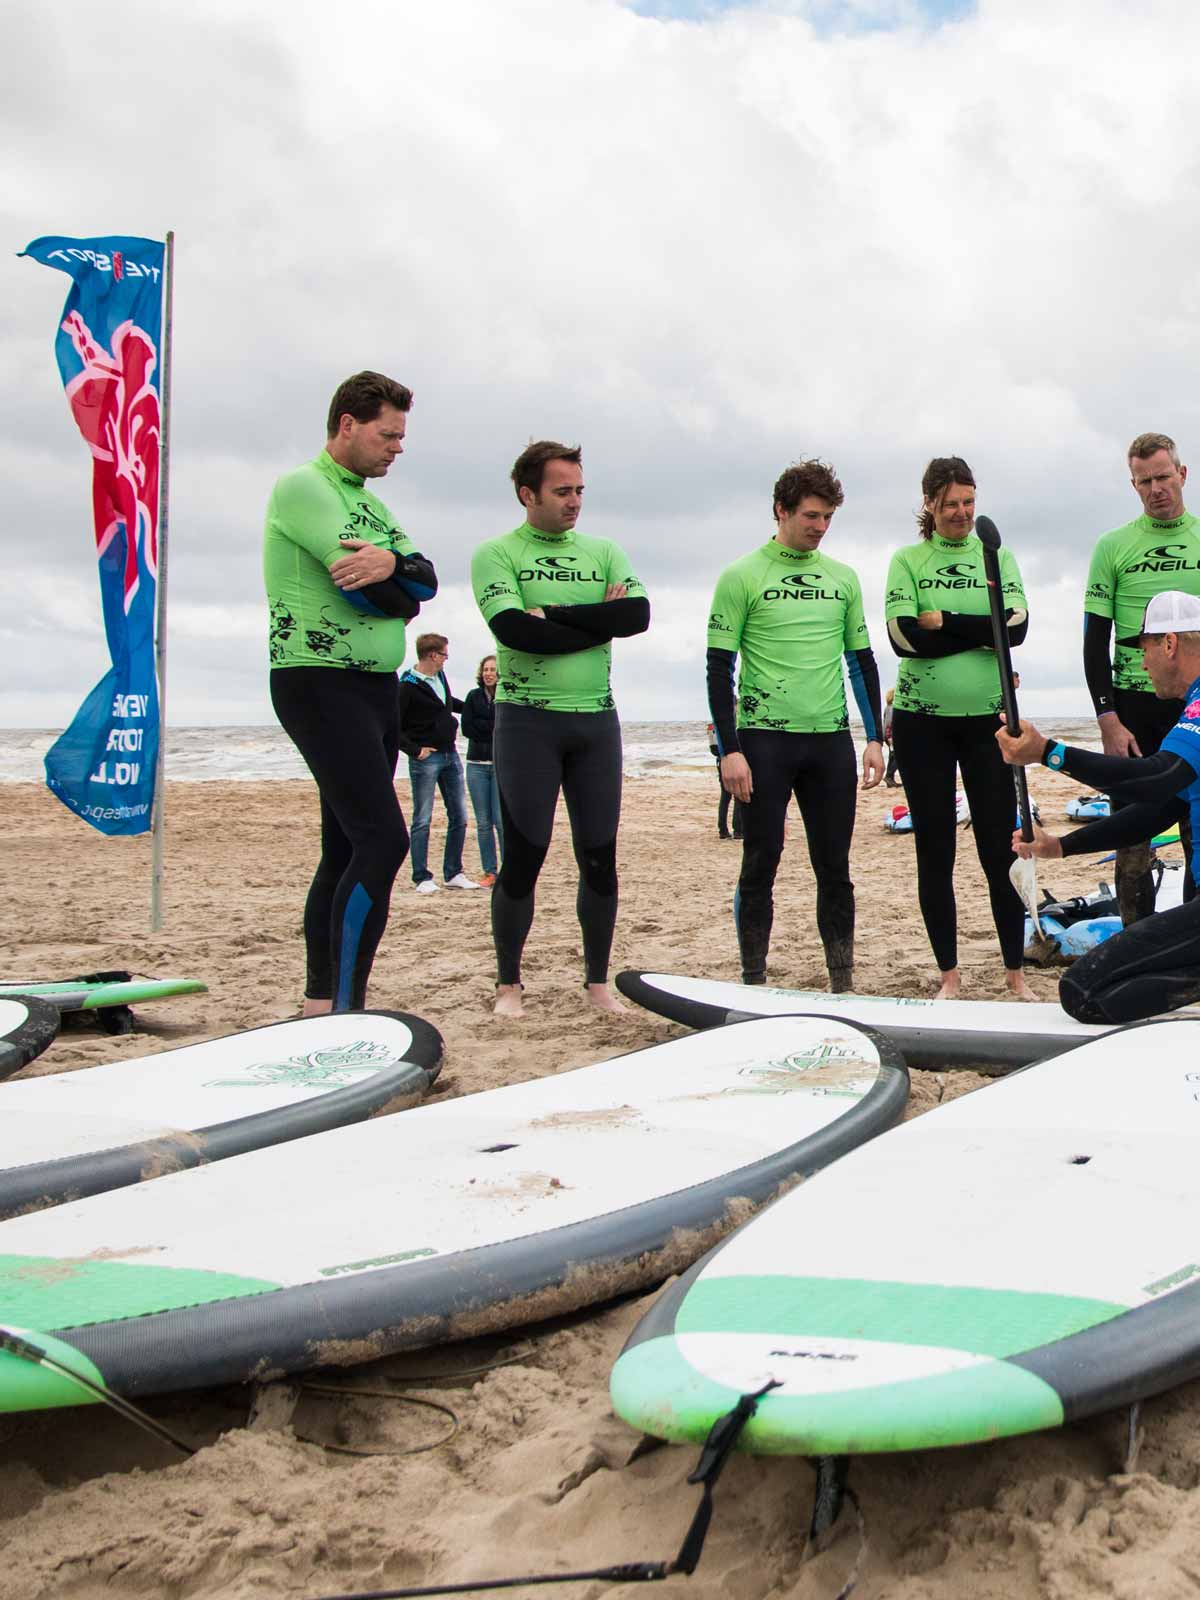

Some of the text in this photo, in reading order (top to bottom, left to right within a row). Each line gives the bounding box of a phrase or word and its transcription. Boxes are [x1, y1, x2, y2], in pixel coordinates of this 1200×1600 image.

[519, 570, 605, 583] O'NEILL
[918, 578, 986, 590] O'NEIL
[763, 589, 846, 601] O'NEILL
